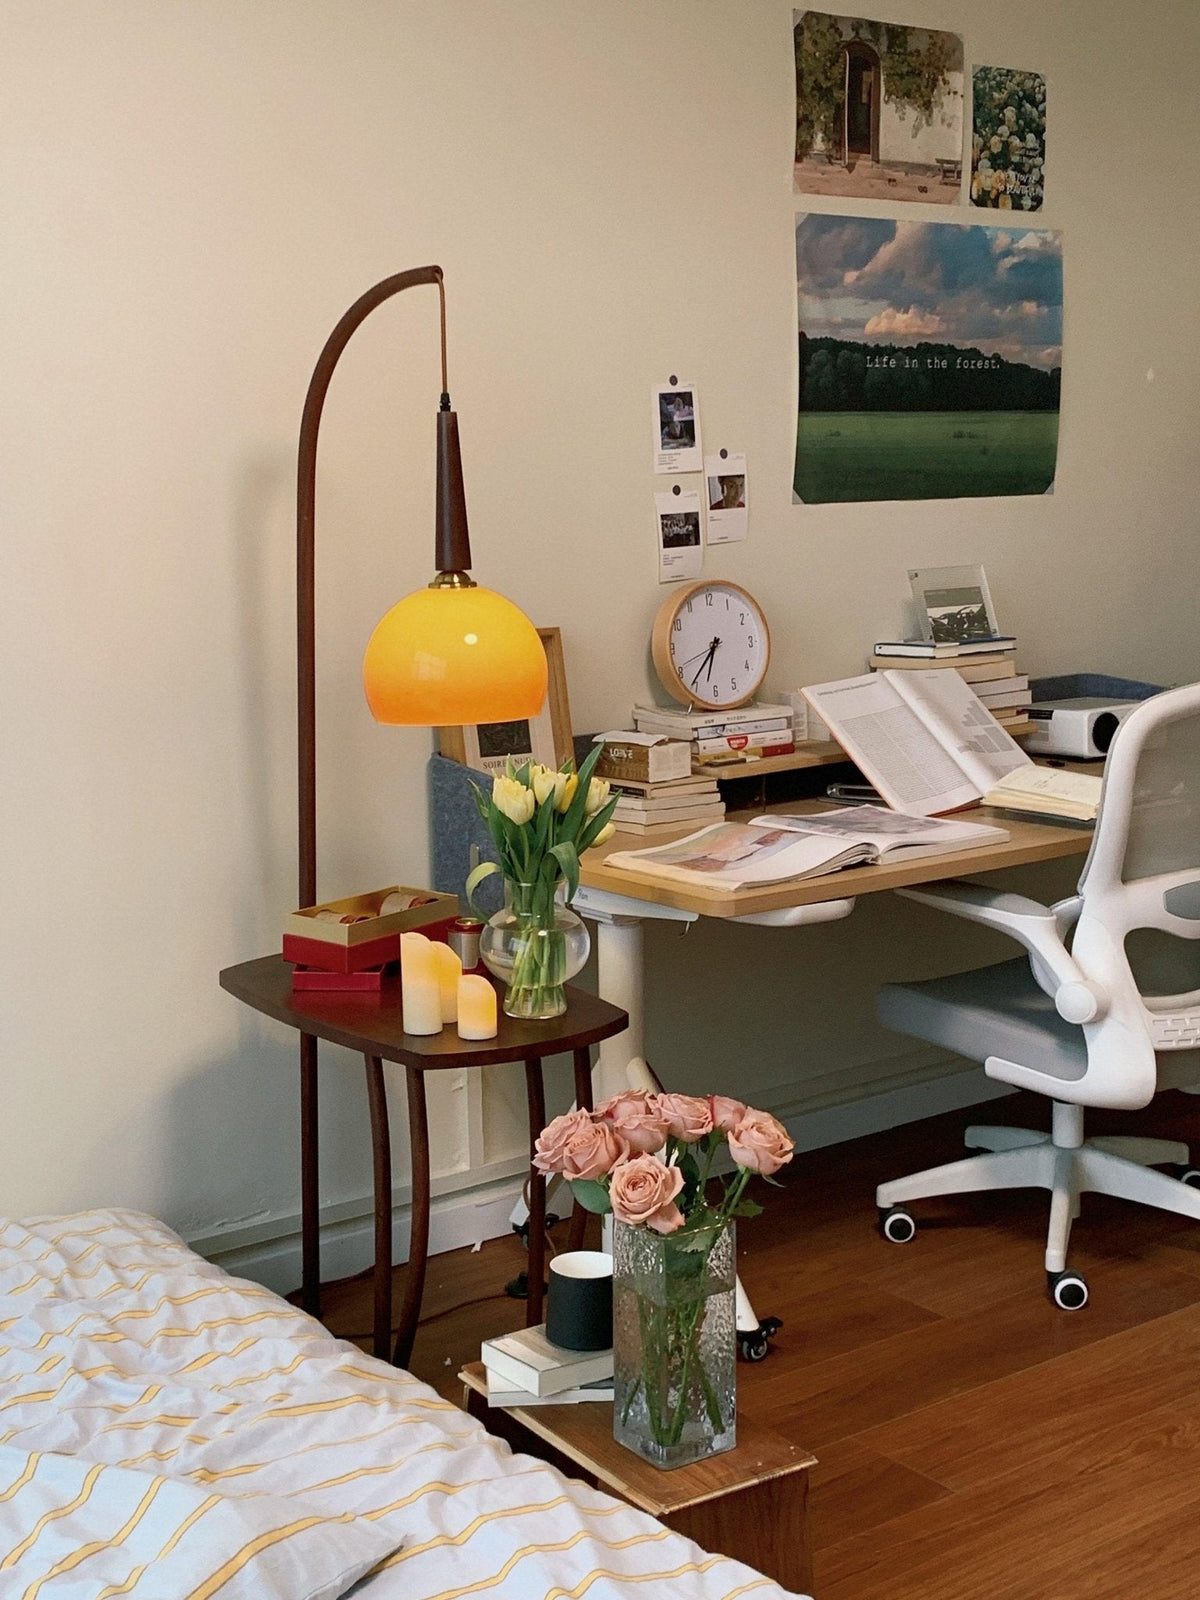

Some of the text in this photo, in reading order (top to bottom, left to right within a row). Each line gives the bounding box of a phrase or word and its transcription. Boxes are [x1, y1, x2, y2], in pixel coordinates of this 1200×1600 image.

[866, 356, 1001, 369] Life in the forest.
[705, 593, 713, 606] 12
[686, 600, 693, 613] 11
[673, 618, 682, 631] 10
[740, 613, 744, 626] 2
[748, 635, 753, 648] 3
[744, 659, 749, 671] 4
[678, 666, 684, 679] 8
[713, 684, 719, 697] 6
[731, 678, 737, 690] 5
